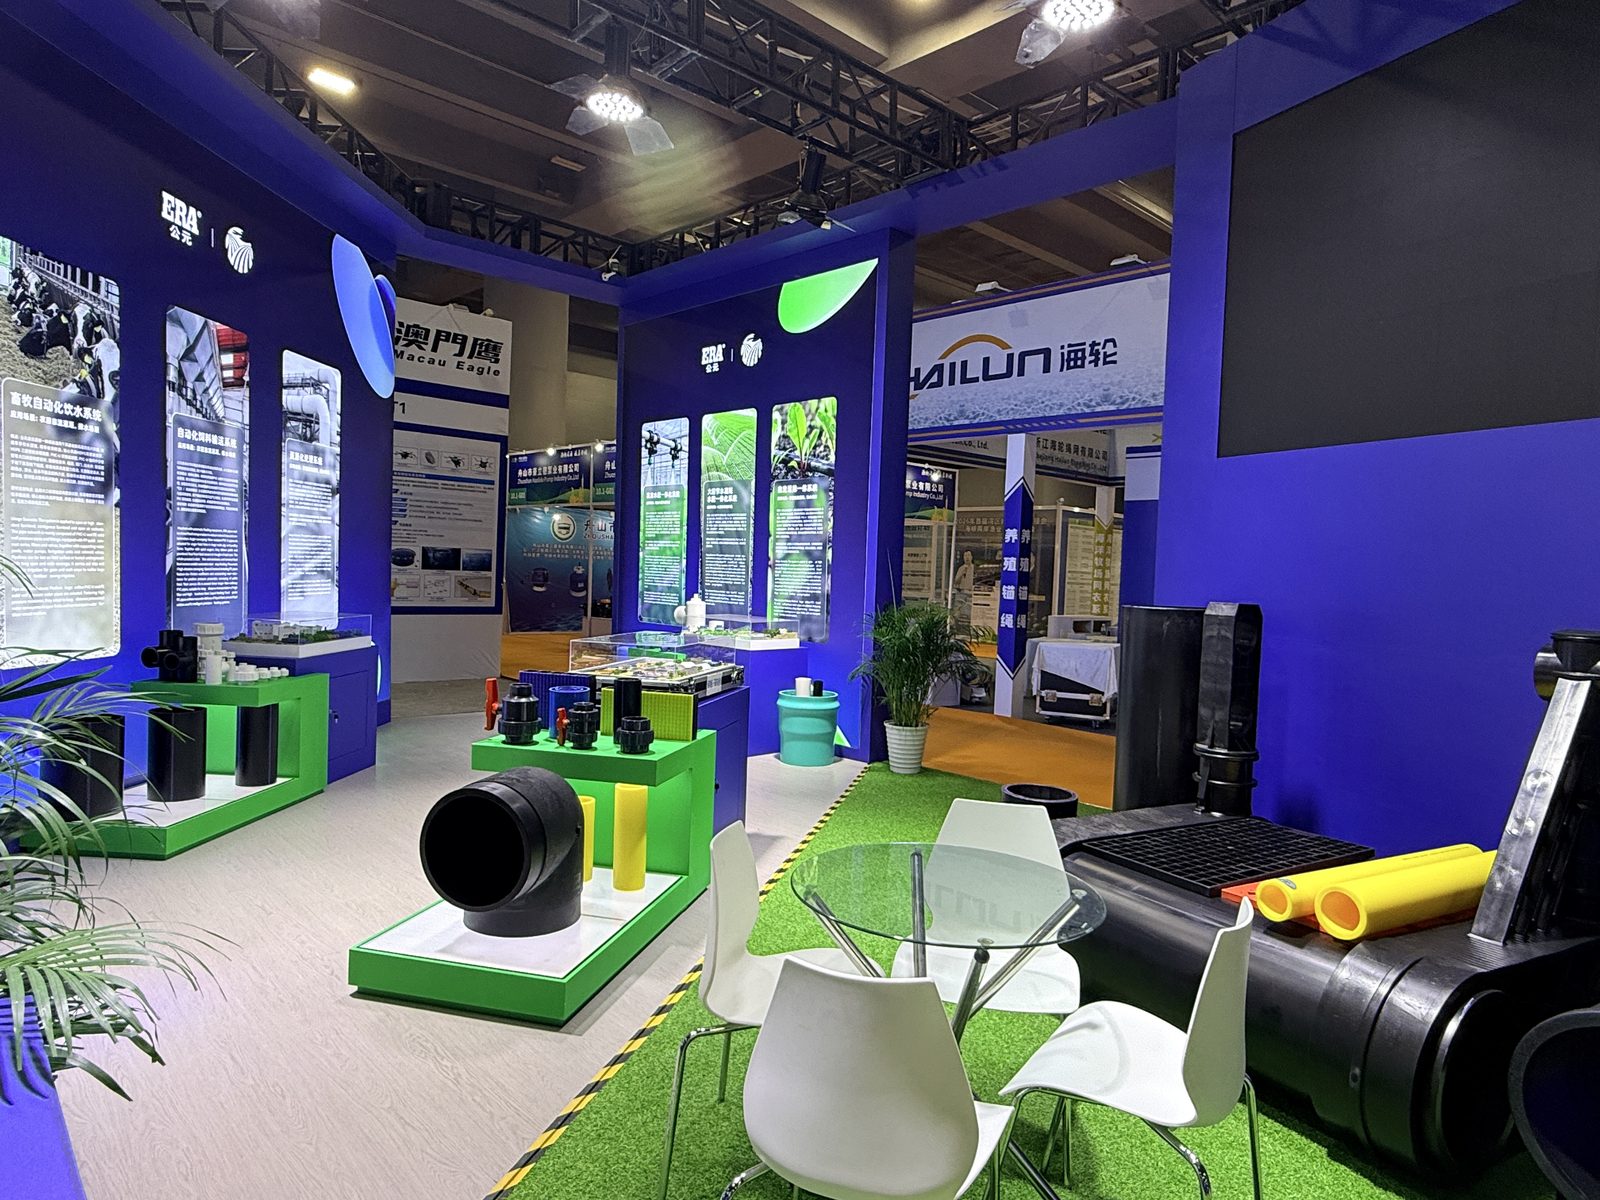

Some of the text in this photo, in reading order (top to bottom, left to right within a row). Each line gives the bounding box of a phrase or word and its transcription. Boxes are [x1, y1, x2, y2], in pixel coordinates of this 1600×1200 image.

[169, 225, 193, 246] 公元
[394, 349, 501, 377] Macau Eagle
[1059, 337, 1118, 373] 海轮
[1000, 528, 1018, 629] 养殖锚绳
